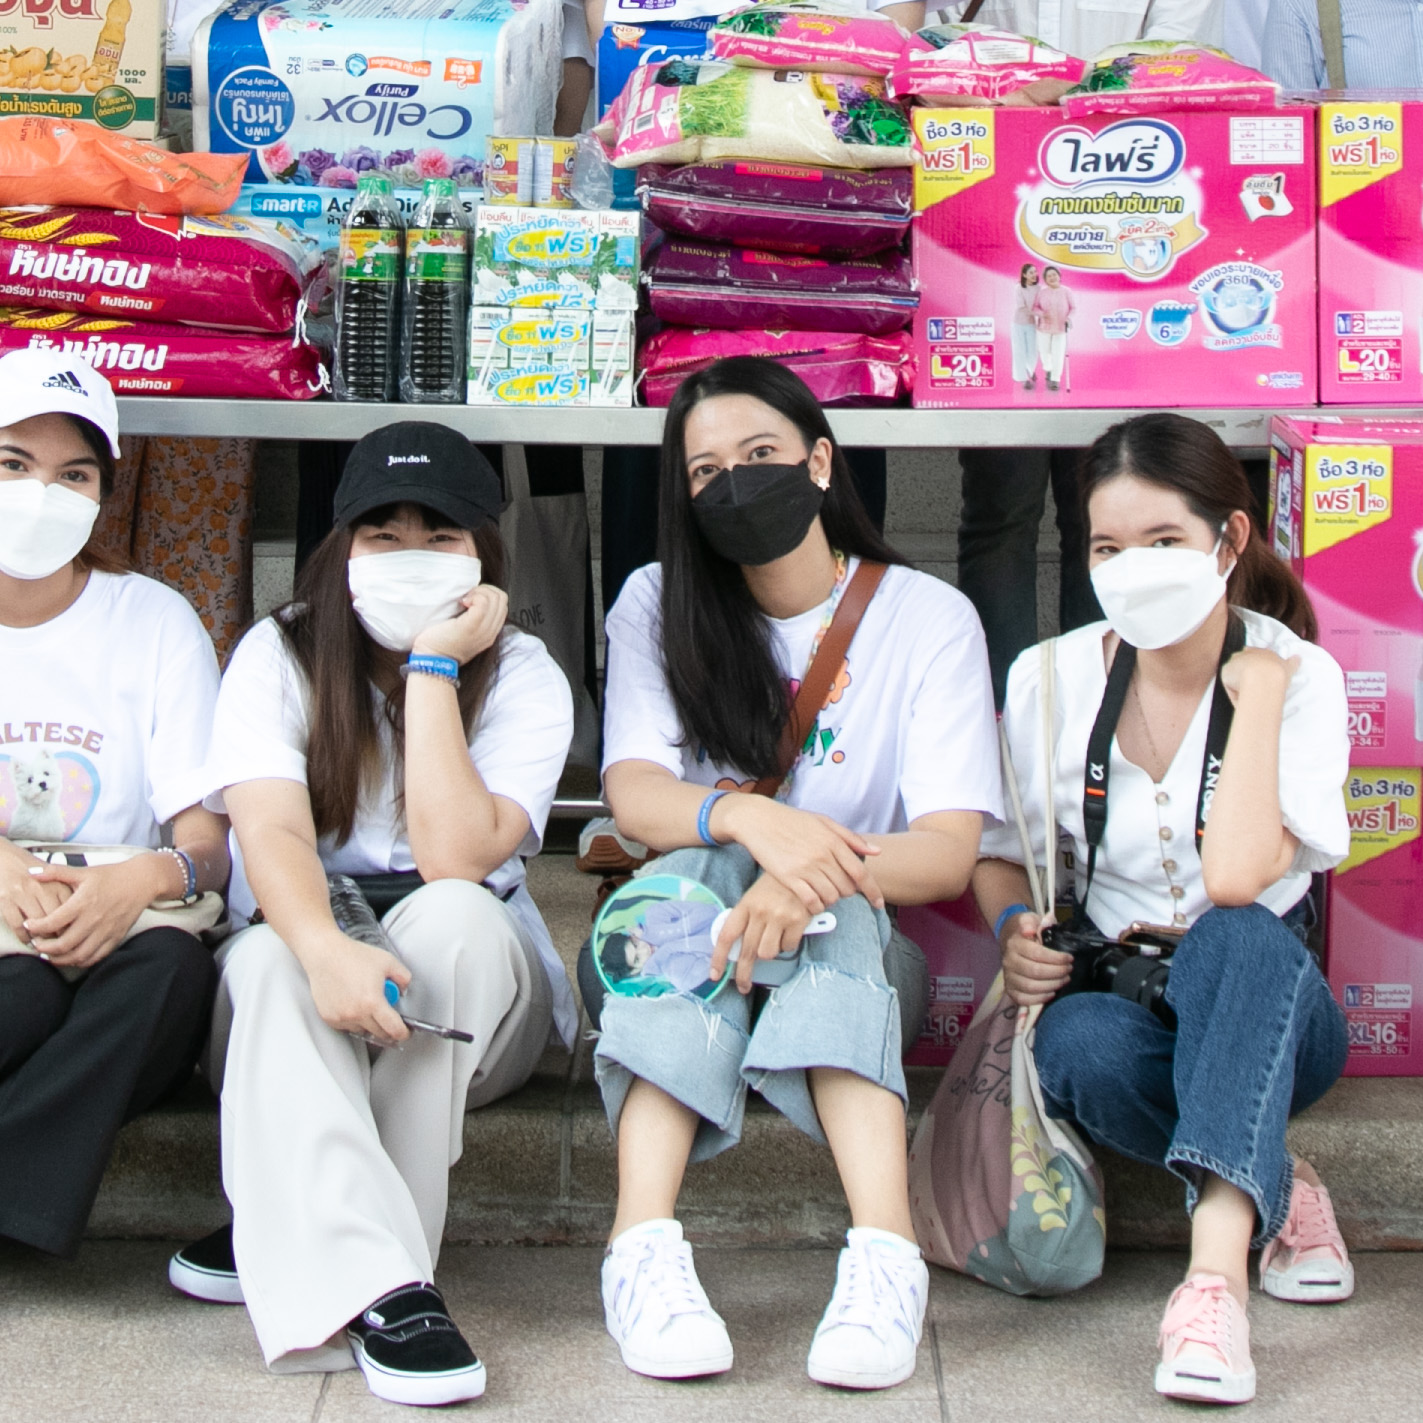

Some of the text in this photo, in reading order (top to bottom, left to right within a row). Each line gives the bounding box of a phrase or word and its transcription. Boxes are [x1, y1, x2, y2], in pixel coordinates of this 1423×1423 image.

[286, 64, 301, 75] 32
[234, 78, 279, 87] Family Pack
[375, 83, 410, 97] Purify
[232, 98, 285, 133] ใหญ่
[313, 94, 472, 140] Cellox
[1333, 116, 1394, 134] ซื้อ 3 ห่อ
[244, 127, 270, 142] แพ็ค
[926, 121, 987, 140] ซื้อ 3 ห่อ
[924, 147, 954, 168] ฟรี
[958, 143, 970, 171] 1
[1331, 142, 1362, 163] ฟรี
[1366, 137, 1377, 164] 1
[1274, 175, 1282, 193] 1
[1040, 191, 1185, 214] กางเกงซึมซับมาก
[1048, 228, 1104, 242] สวมง่าย
[1144, 220, 1156, 234] 2
[547, 229, 586, 255] ฟรี
[589, 234, 599, 252] 1
[8, 247, 152, 290] หงษ์ทอง
[37, 286, 85, 303] มาตรฐาน
[100, 294, 153, 311] หงษ์ทอง
[580, 321, 589, 337] 1
[945, 327, 956, 338] 2
[1159, 325, 1170, 339] 6
[1353, 321, 1364, 332] 2
[931, 355, 952, 377] L
[952, 355, 981, 377] 20
[1339, 349, 1360, 372] L
[1360, 349, 1389, 372] 20
[42, 382, 89, 397] adidas
[118, 378, 172, 391] หงษ์ทอง
[537, 371, 575, 396] ฟรี
[579, 377, 588, 392] 1
[387, 454, 431, 466] Just do it.
[1319, 459, 1385, 478] ซื้อ 3 ห่อ
[1315, 489, 1349, 510] ฟรี
[1353, 482, 1366, 513] 1
[1348, 712, 1372, 735] 20
[1350, 778, 1415, 798] ซื้อ 3 ห่อ
[1383, 801, 1397, 832] 1
[1363, 993, 1373, 1005] 2
[935, 1015, 960, 1037] 16
[1348, 1022, 1374, 1044] XL
[1374, 1022, 1397, 1044] 16
[1370, 1046, 1398, 1055] 35-50
